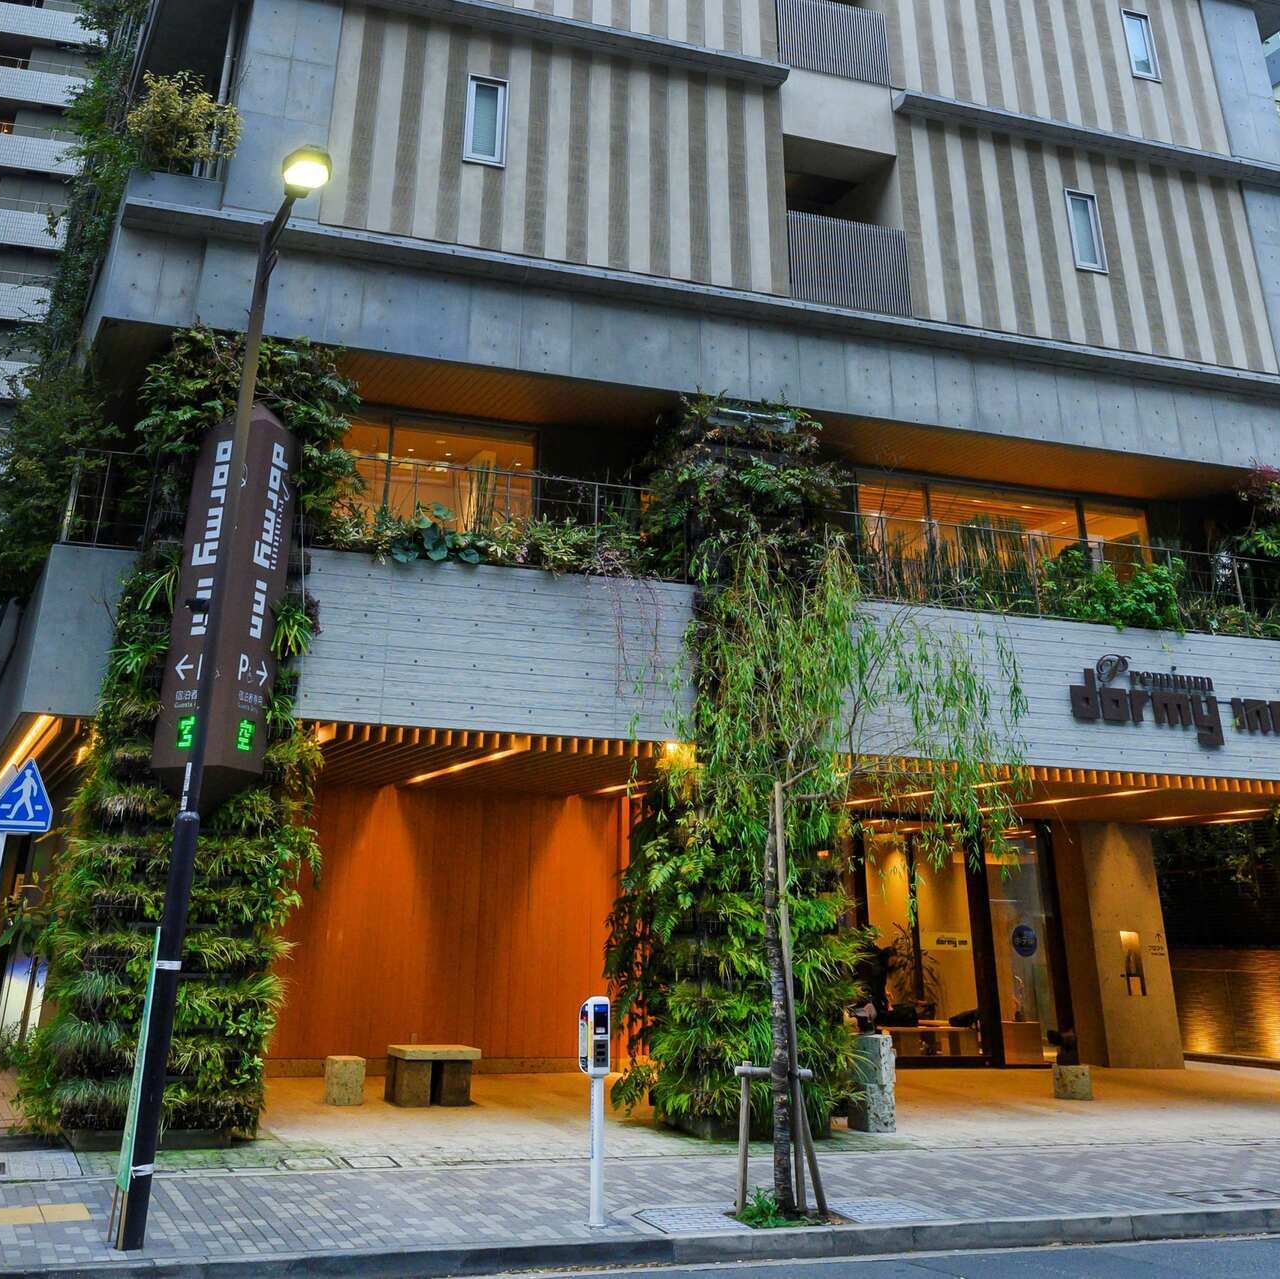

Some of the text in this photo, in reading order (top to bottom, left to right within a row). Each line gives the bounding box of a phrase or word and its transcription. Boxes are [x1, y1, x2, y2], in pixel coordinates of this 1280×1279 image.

[249, 442, 289, 640] dormy inn
[238, 653, 249, 681] P
[1096, 654, 1214, 692] Premium
[1070, 668, 1224, 746] dormy
